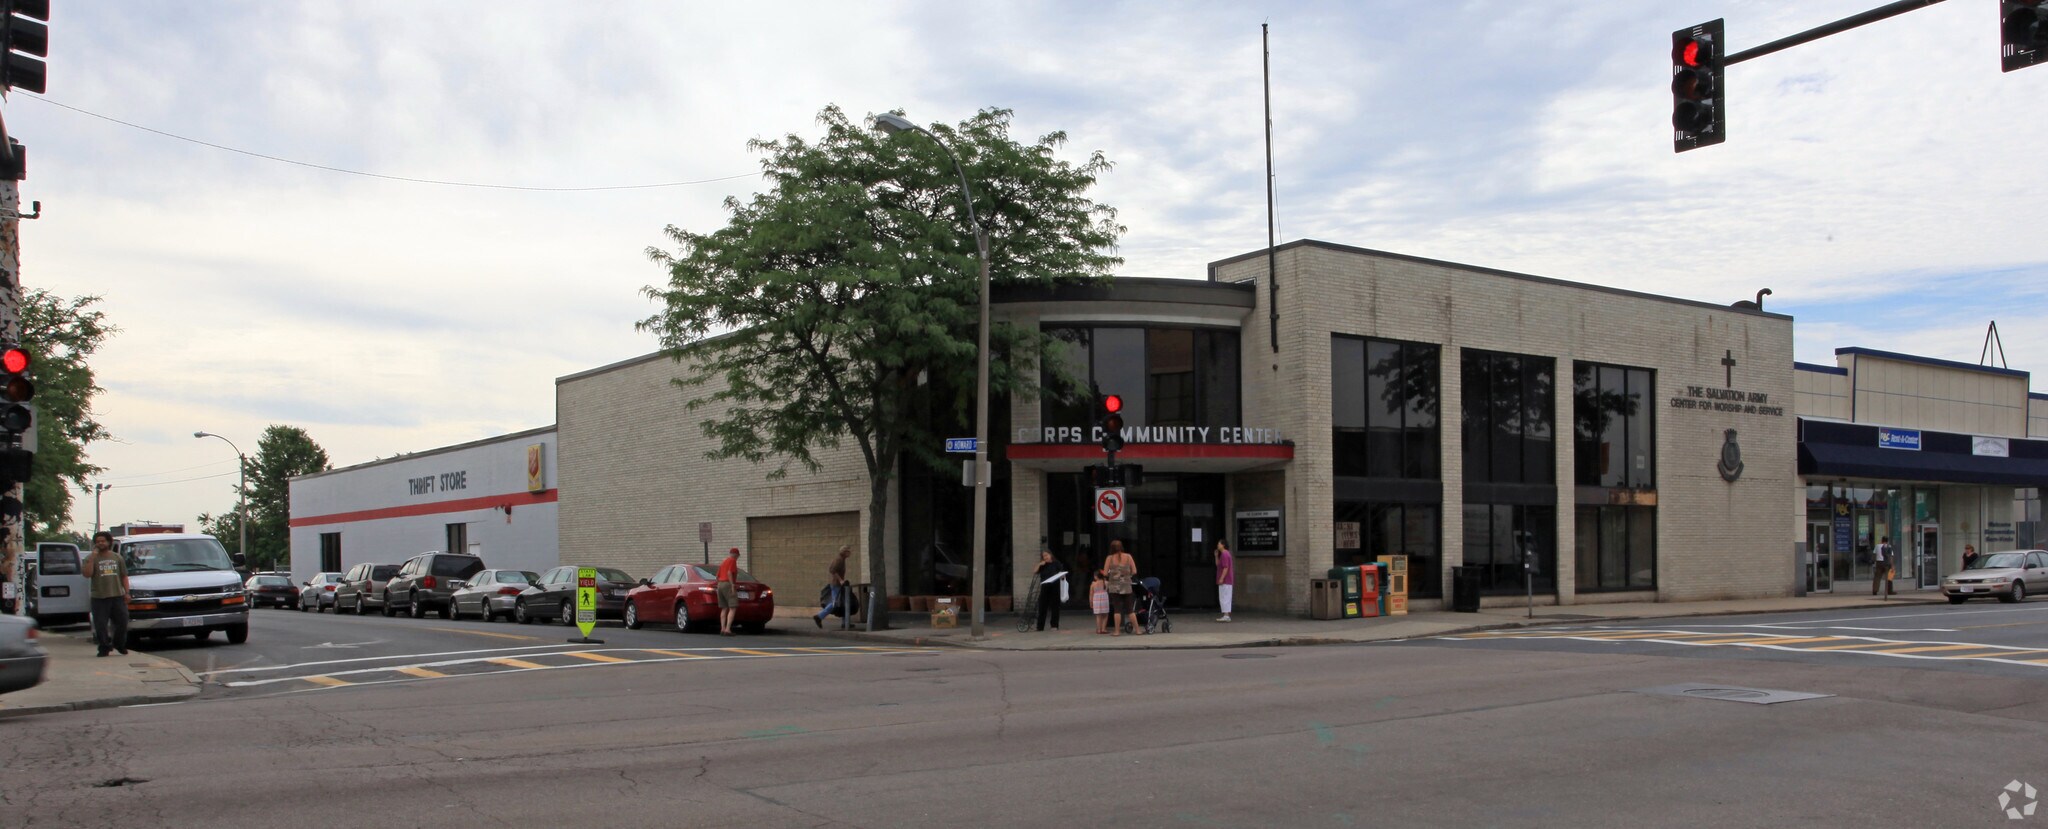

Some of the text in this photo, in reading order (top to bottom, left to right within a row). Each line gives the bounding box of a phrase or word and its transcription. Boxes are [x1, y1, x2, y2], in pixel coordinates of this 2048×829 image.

[1687, 386, 1768, 404] THE SALVATION ARMY
[1671, 398, 1783, 416] CENTER FOR WORSHIP AND SERVICE
[1092, 426, 1209, 443] CMMUNITY
[1220, 427, 1283, 444] CENTER
[954, 440, 972, 450] HOWARD
[409, 470, 467, 495] THRIFT STORE
